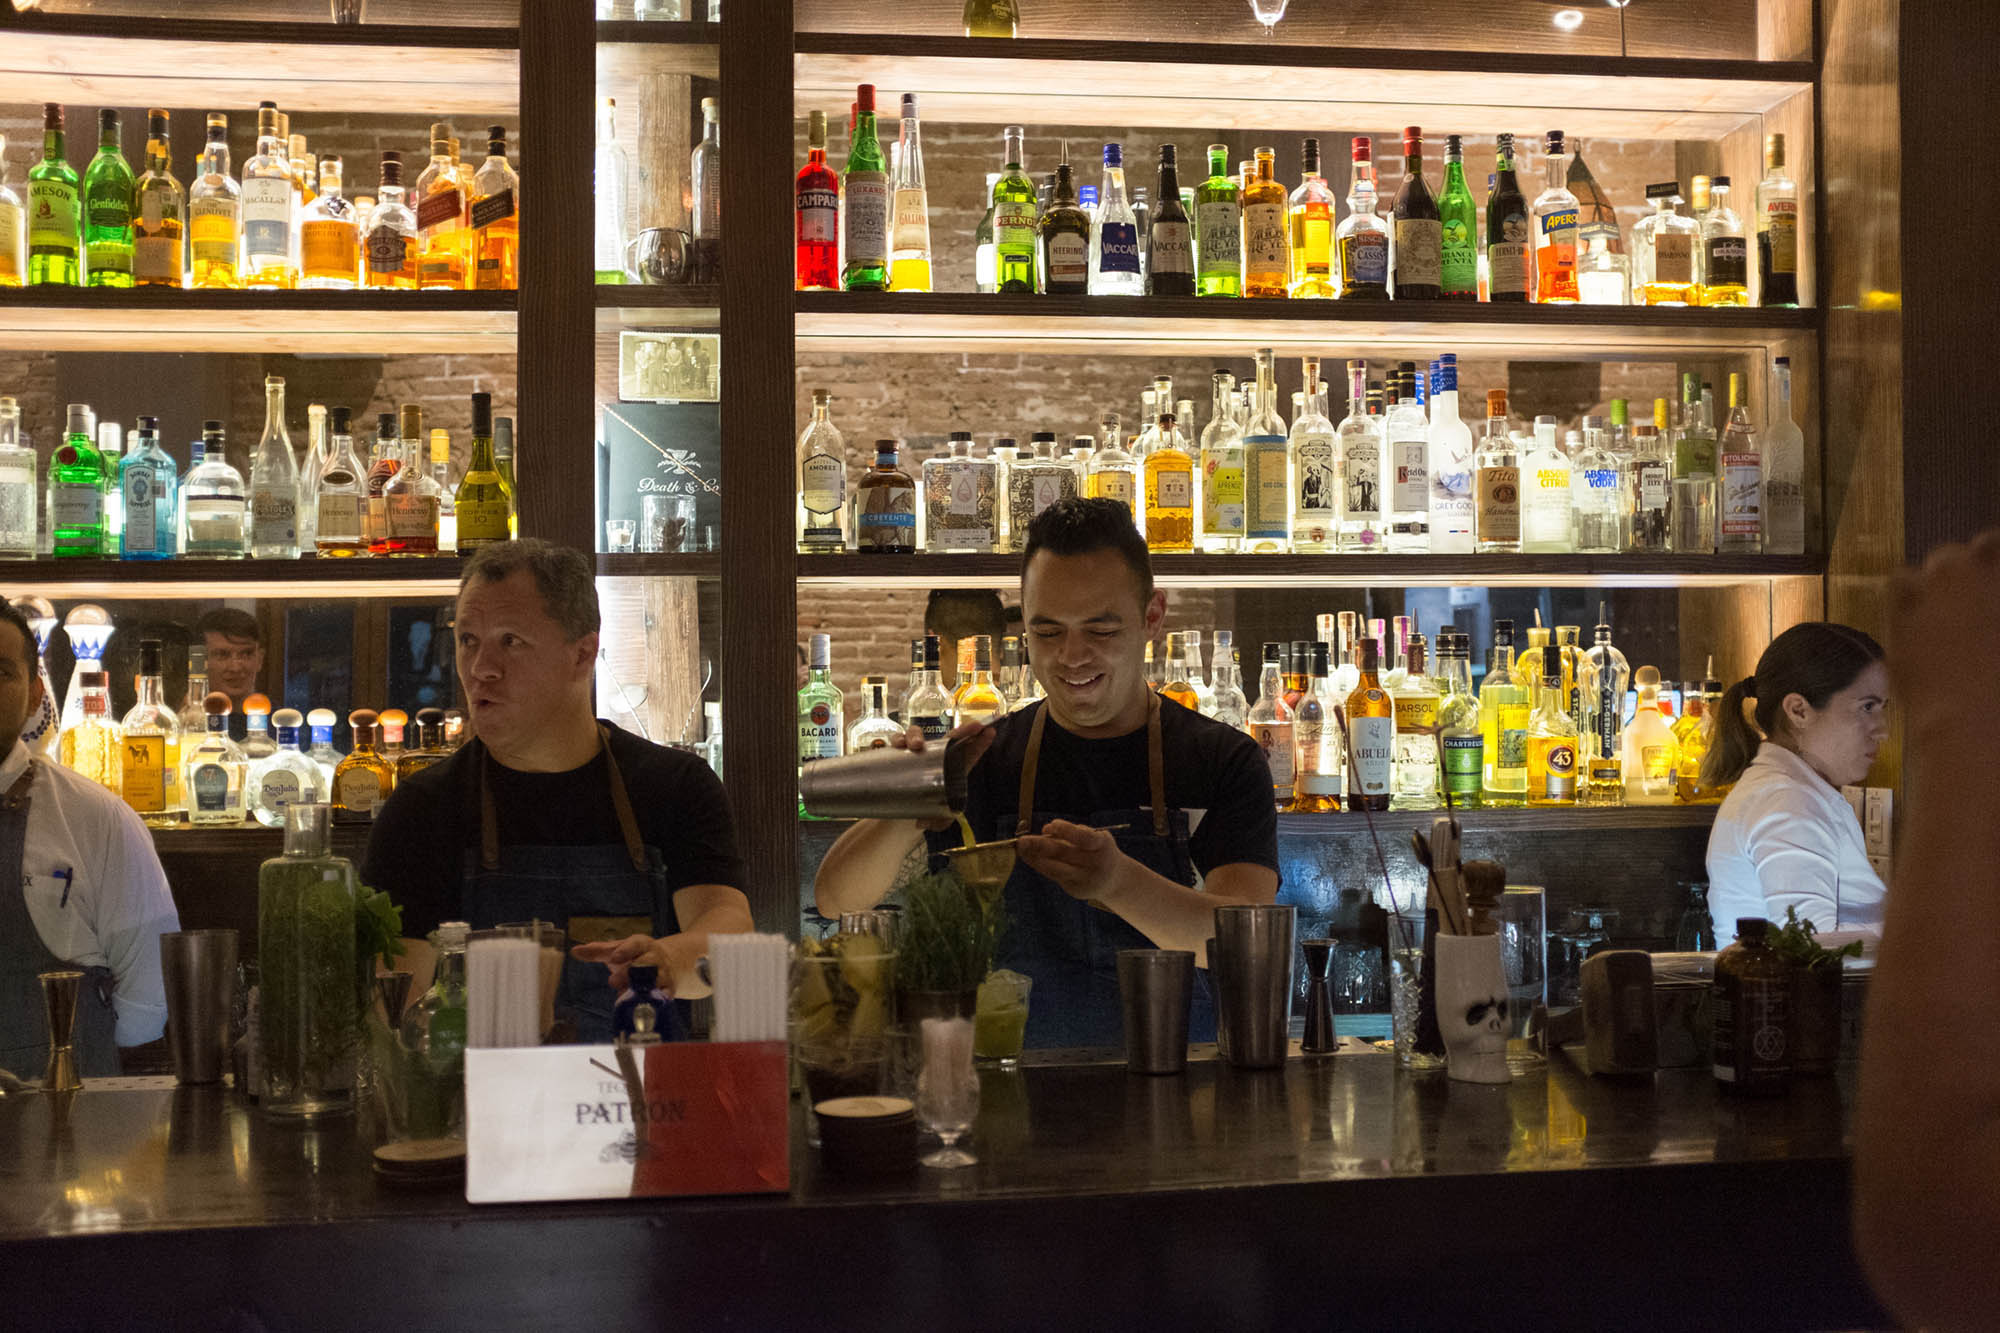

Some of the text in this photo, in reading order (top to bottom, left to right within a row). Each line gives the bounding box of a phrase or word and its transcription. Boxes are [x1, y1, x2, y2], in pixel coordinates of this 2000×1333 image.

[1102, 241, 1138, 257] VACCAR
[636, 477, 682, 493] Death
[684, 481, 700, 494] &
[1395, 703, 1433, 713] BARSOL
[1552, 751, 1572, 766] 43
